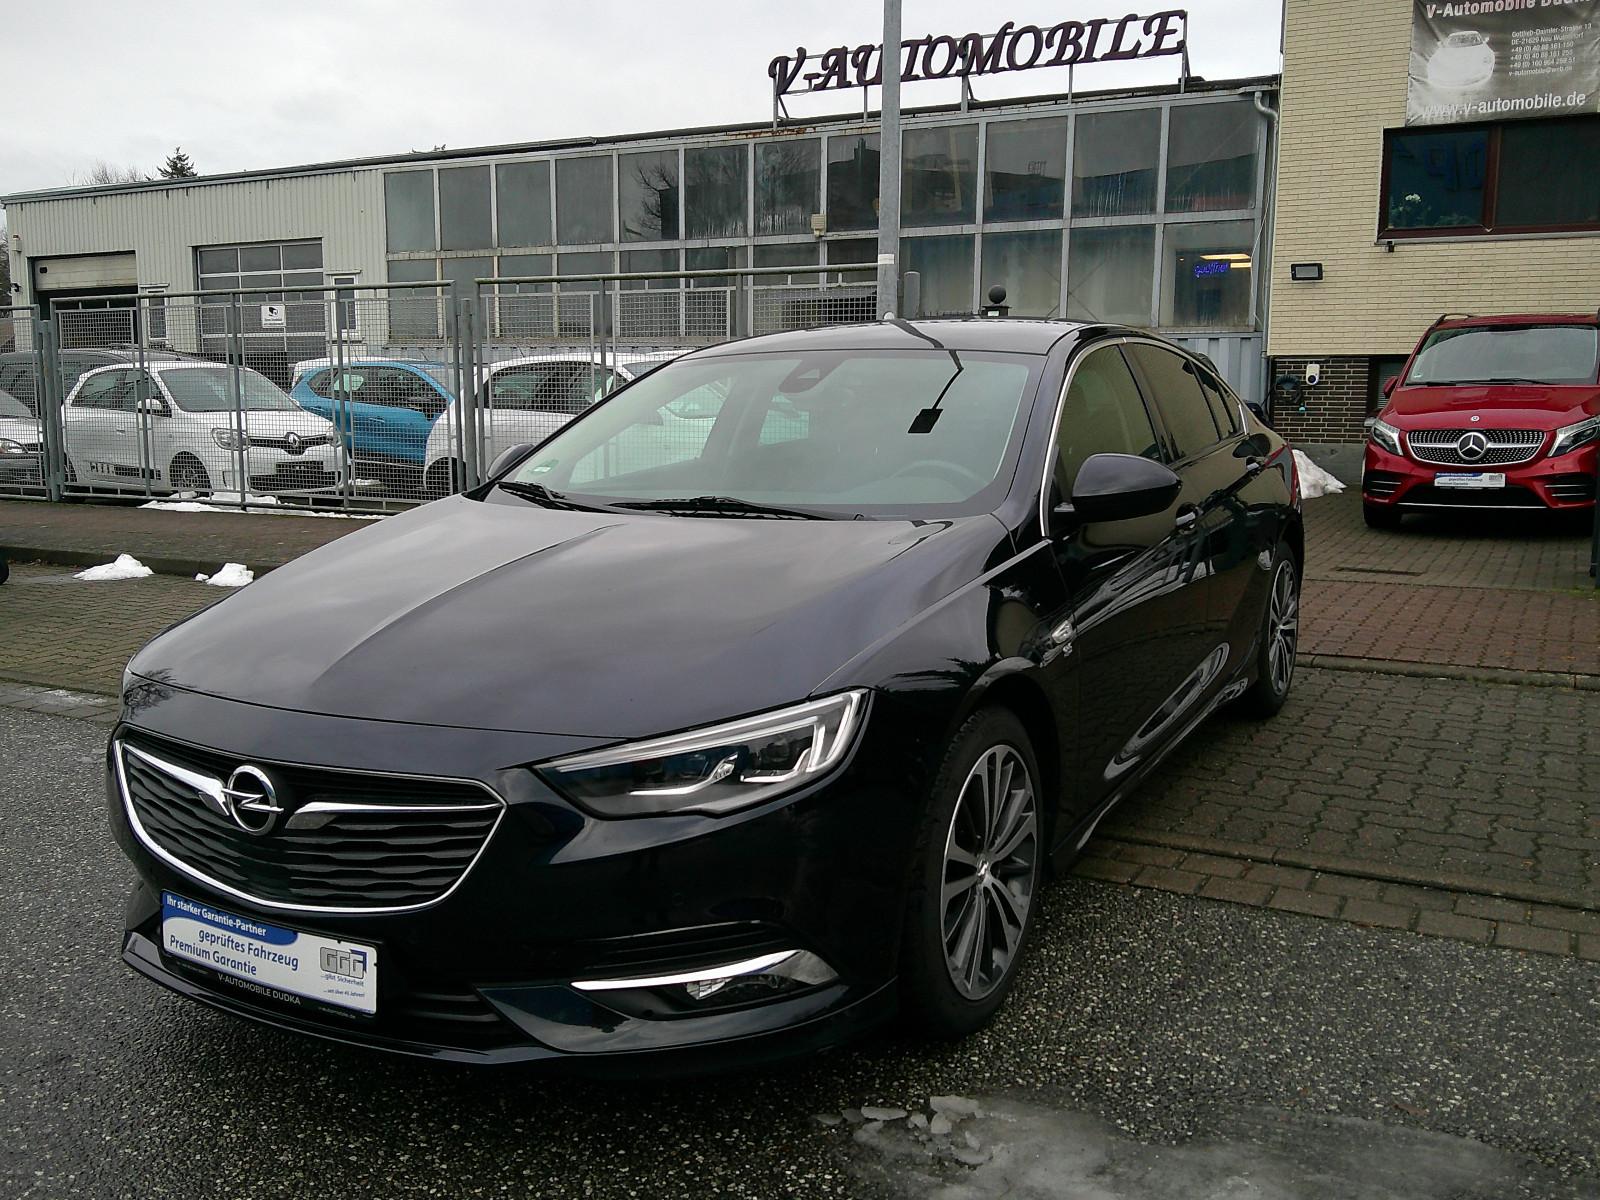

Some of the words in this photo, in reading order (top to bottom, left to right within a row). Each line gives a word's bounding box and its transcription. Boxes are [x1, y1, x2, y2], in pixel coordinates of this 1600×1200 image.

[768, 9, 1187, 94] V-AUTOMOBILE
[1422, 91, 1586, 121] www.v-automobile.de
[166, 895, 177, 907] Ihr
[177, 899, 201, 917] starker
[201, 908, 267, 937] Garantie-Partner
[169, 934, 211, 960] Premium
[212, 949, 257, 975] Garantie
[198, 928, 245, 953] geprüftes
[247, 943, 299, 971] Fahrzeug
[217, 973, 271, 997] V-AUTOMOBILE
[272, 989, 301, 1005] DUDKA
